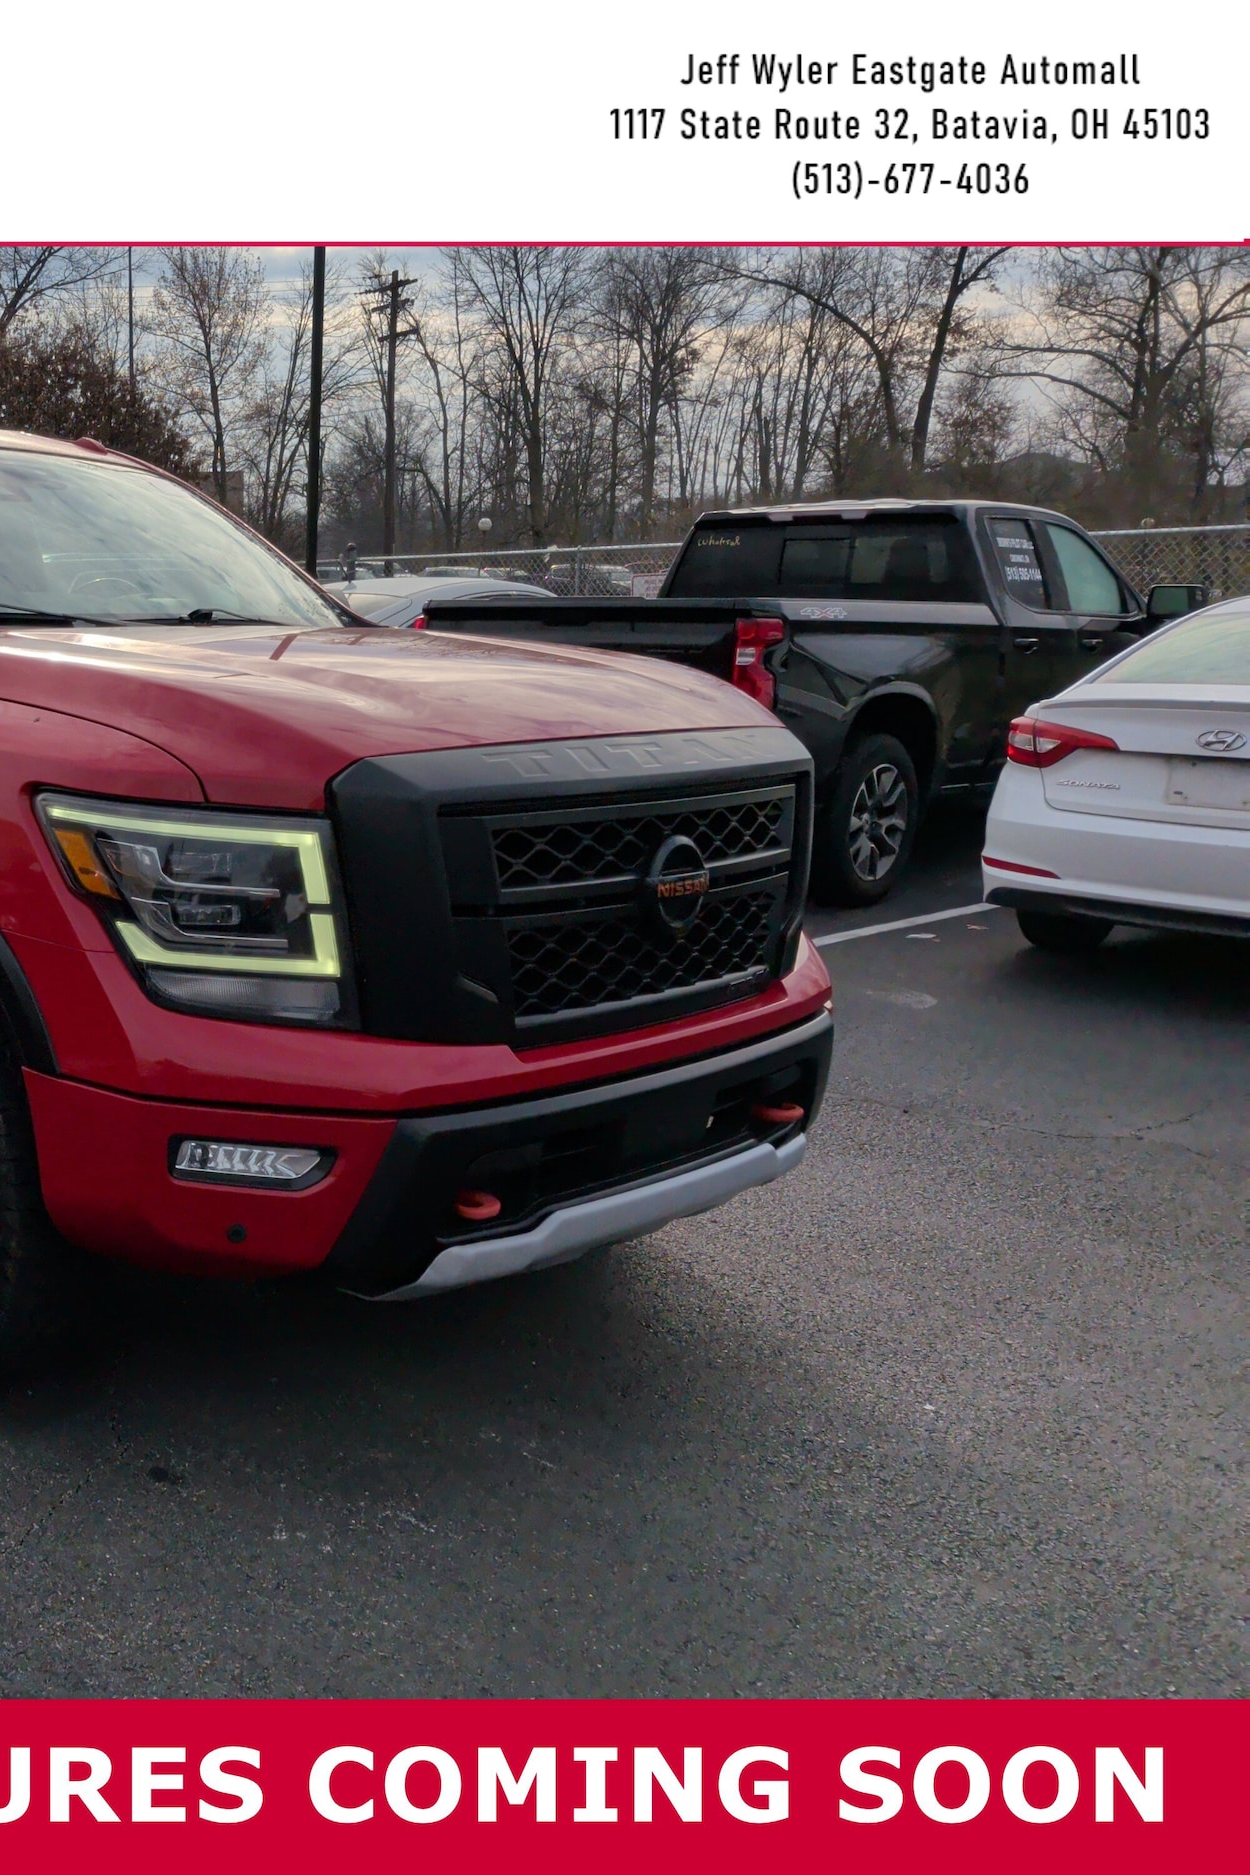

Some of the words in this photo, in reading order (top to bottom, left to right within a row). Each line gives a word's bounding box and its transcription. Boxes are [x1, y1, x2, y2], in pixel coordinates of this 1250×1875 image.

[482, 734, 774, 778] TITAN
[1056, 779, 1121, 790] SONATA
[657, 874, 709, 898] NISSAN
